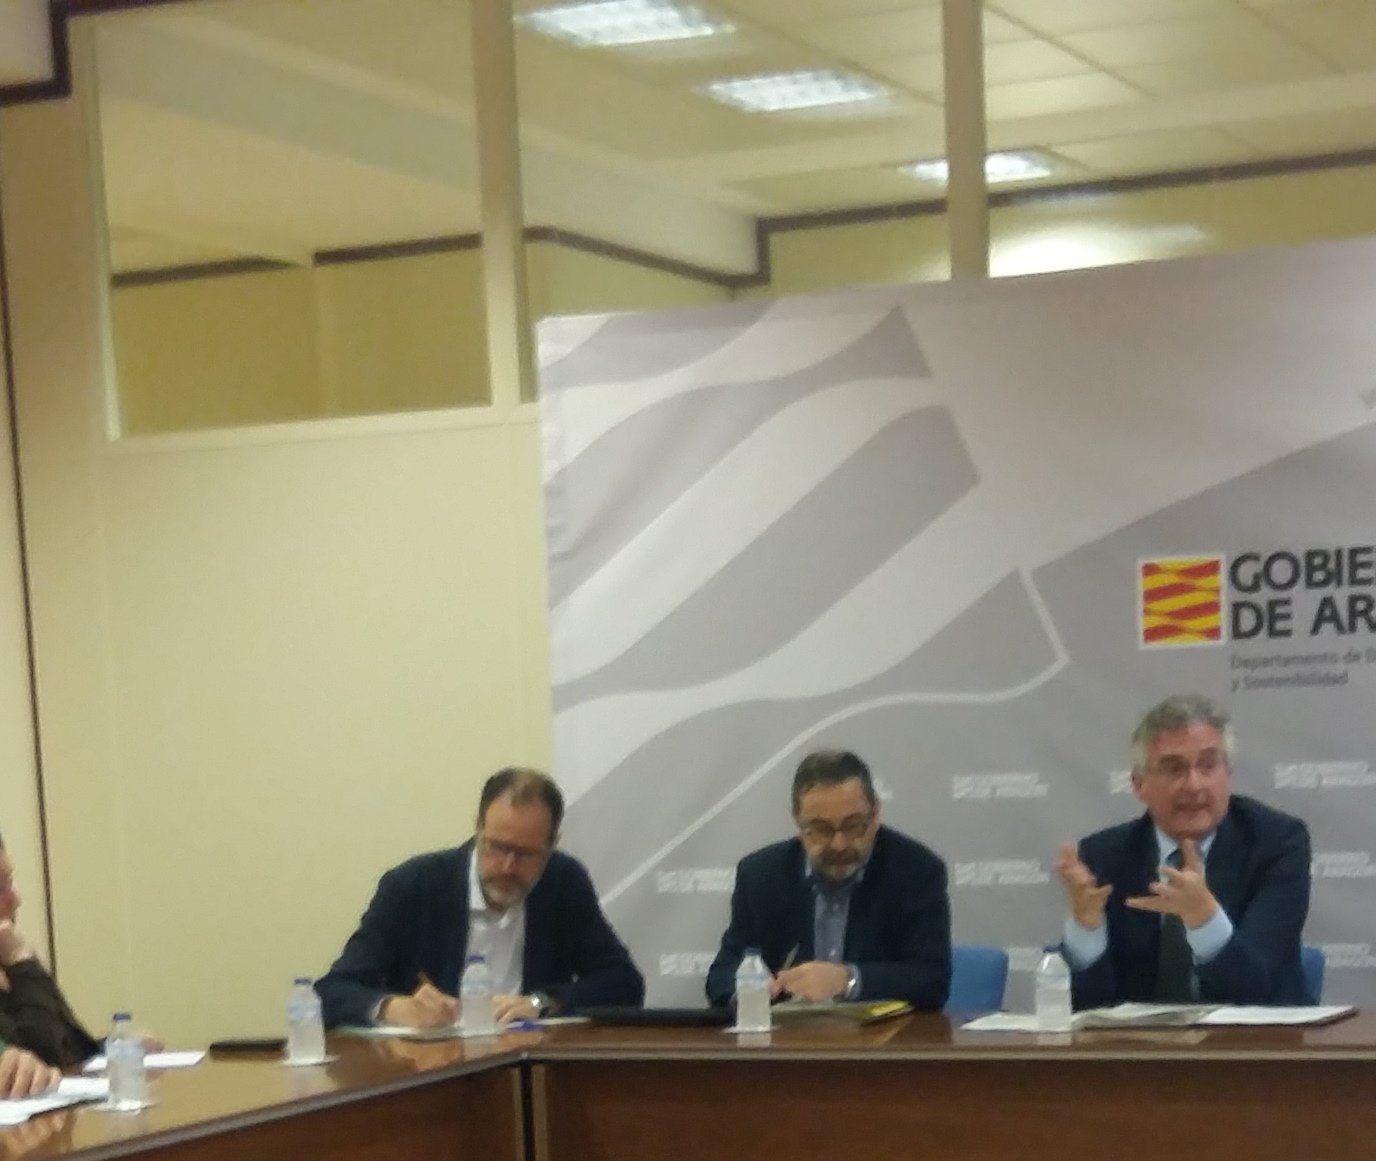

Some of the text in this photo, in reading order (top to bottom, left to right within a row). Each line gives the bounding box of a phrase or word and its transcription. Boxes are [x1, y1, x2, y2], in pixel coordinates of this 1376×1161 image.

[1231, 599, 1293, 640] DE
[1231, 651, 1339, 672] Departamento
[1343, 649, 1362, 664] de
[1243, 670, 1349, 690] Sostenibilidad
